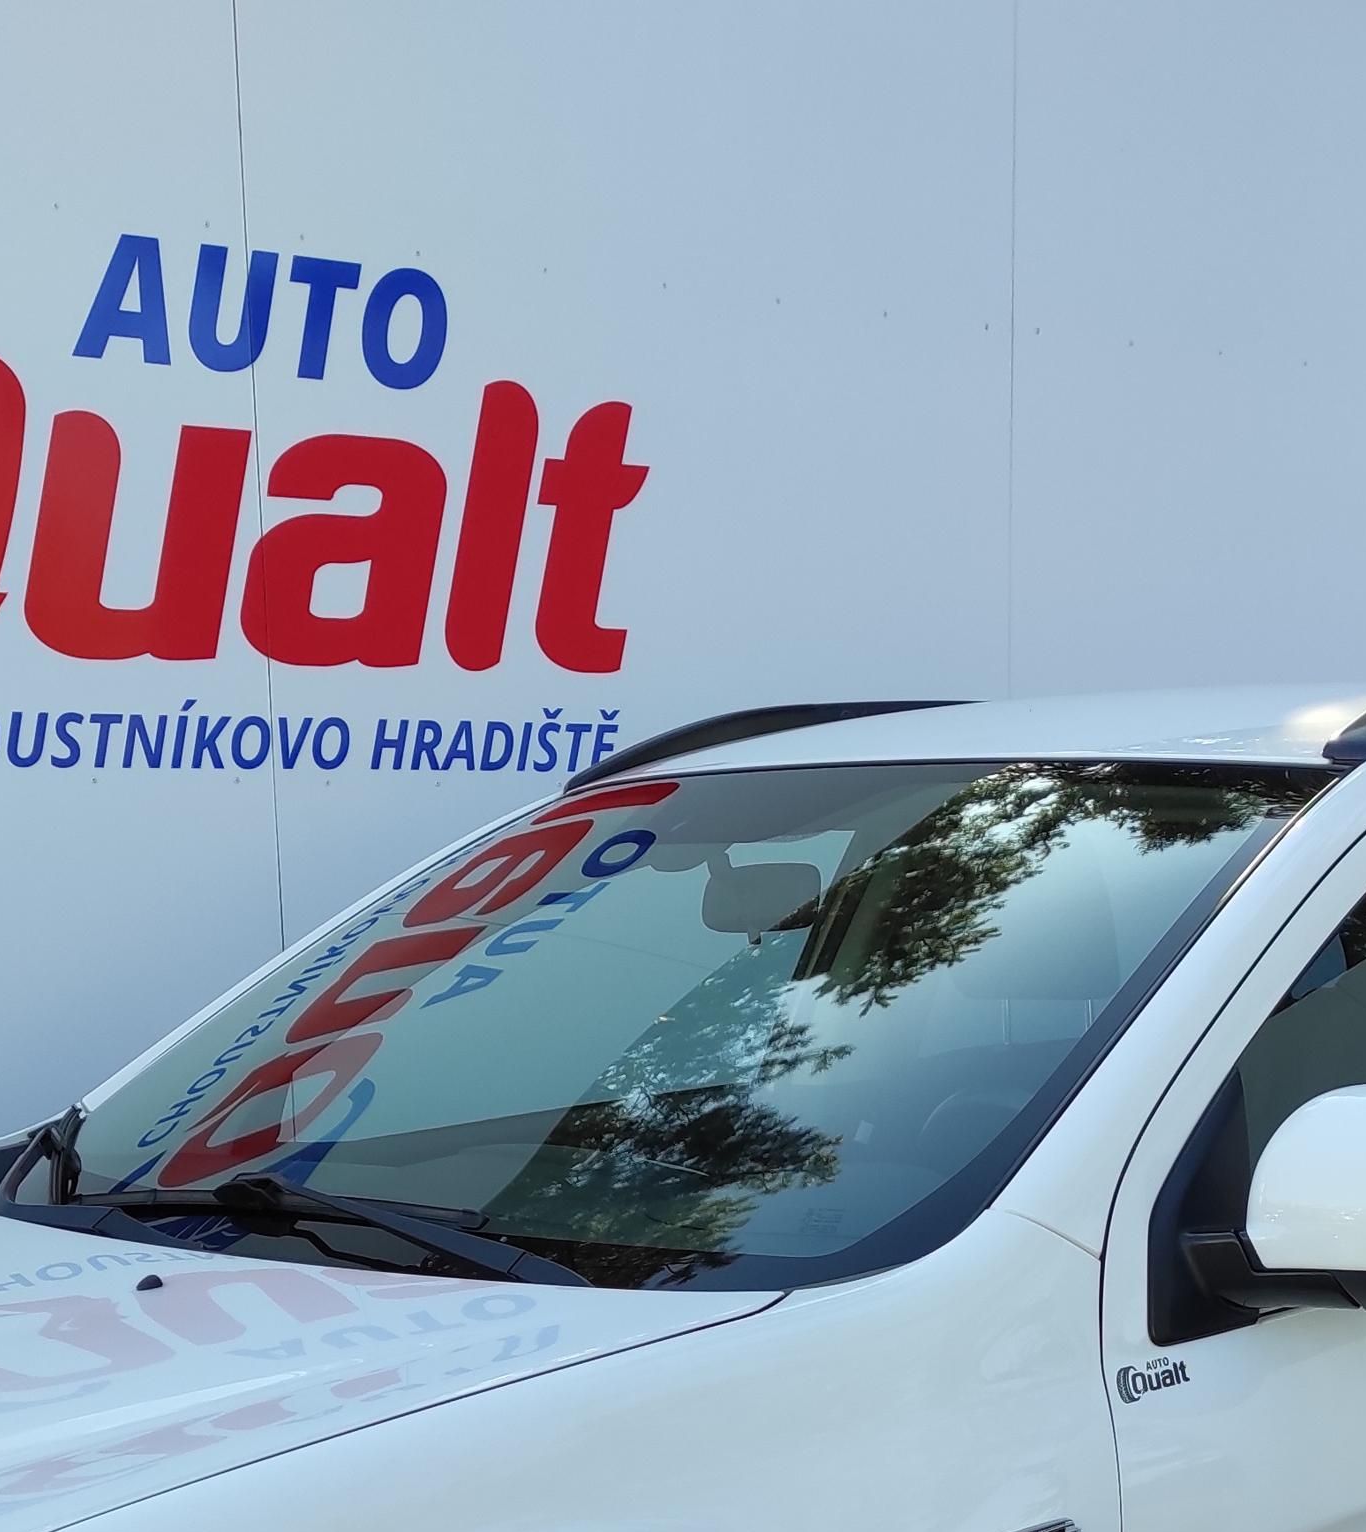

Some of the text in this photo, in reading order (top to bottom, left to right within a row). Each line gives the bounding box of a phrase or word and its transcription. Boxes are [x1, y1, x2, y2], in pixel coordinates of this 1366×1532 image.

[72, 233, 448, 390] AUTO
[370, 707, 620, 773] HRADIŠTĚ
[1131, 1361, 1190, 1394] Qualt
[1146, 1357, 1169, 1371] AUTO
